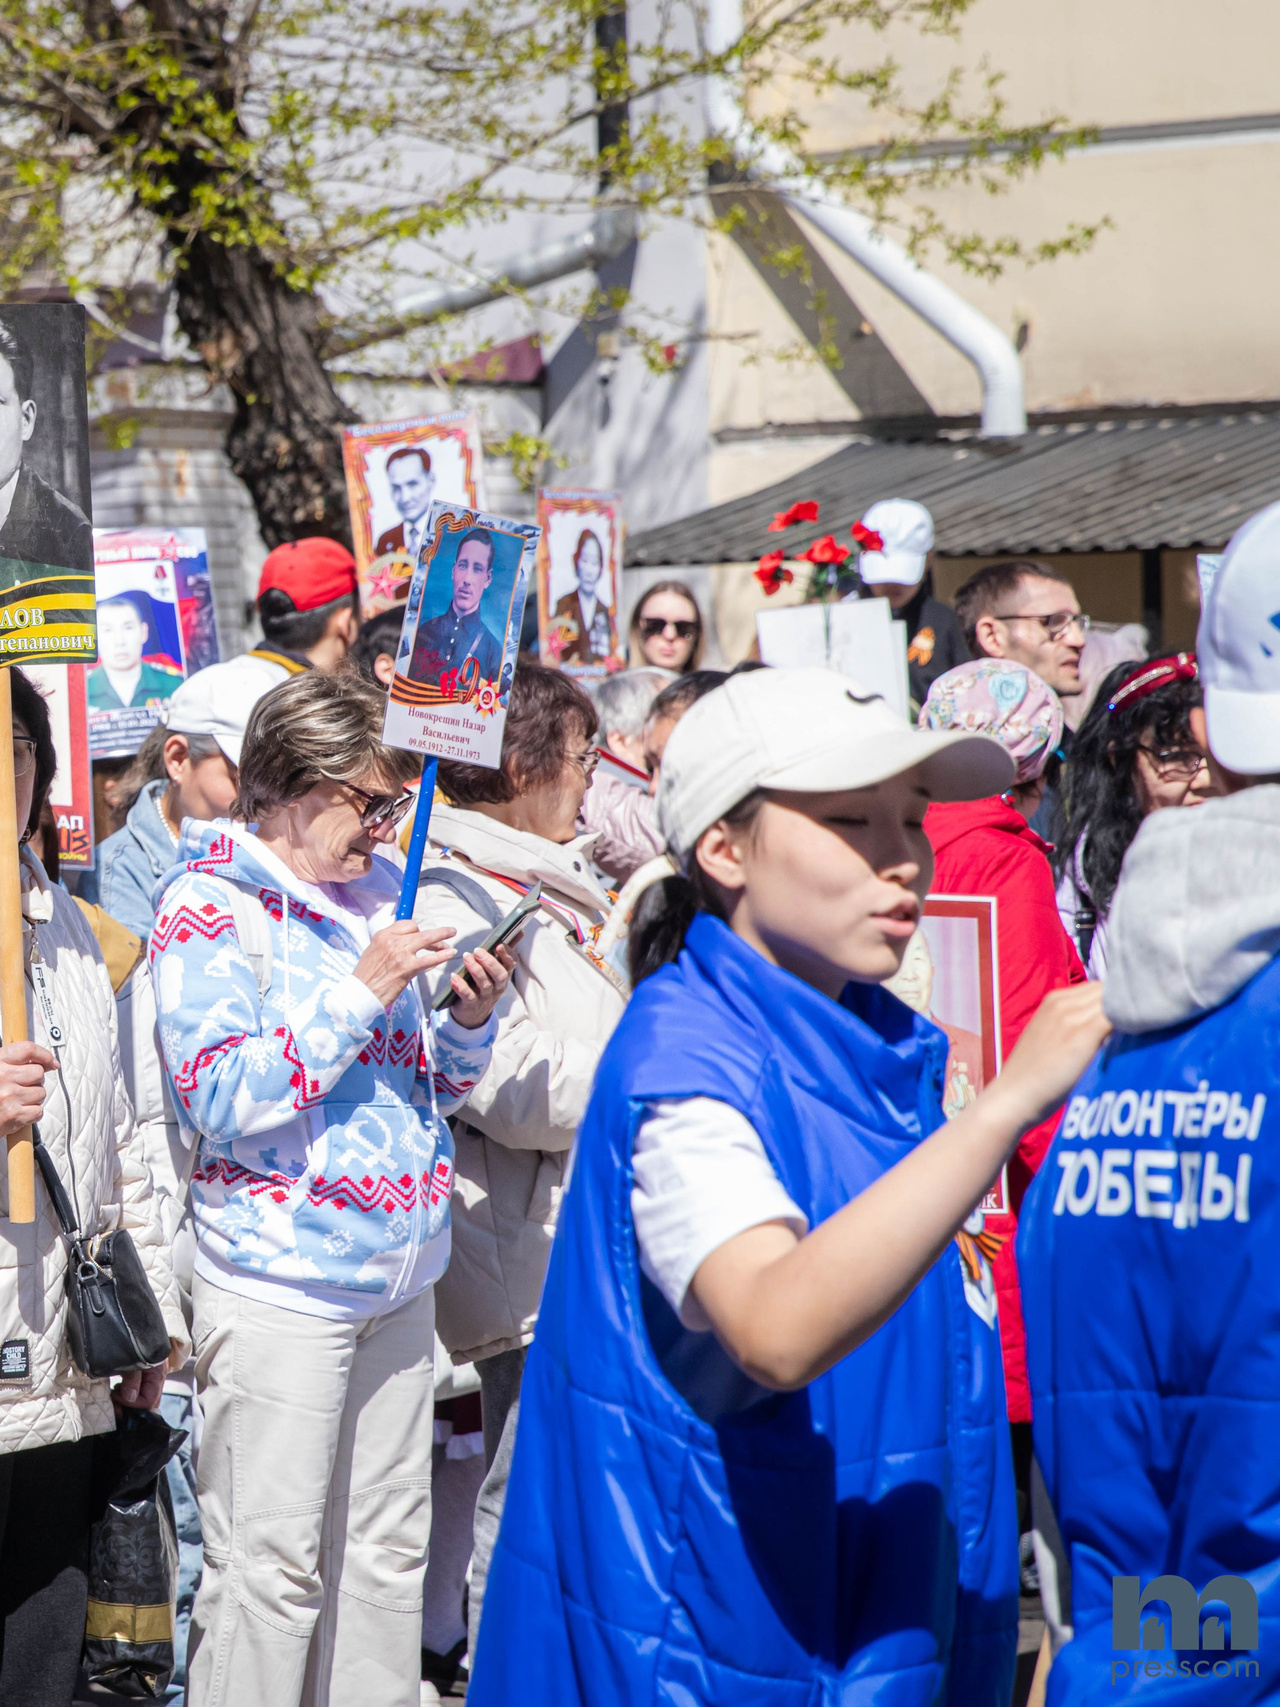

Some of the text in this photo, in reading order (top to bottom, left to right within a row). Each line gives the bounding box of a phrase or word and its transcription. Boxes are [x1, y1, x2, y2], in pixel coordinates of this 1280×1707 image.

[462, 719, 486, 734] Назар
[422, 726, 470, 745] Васильевич
[408, 738, 443, 753] 09.05.1912
